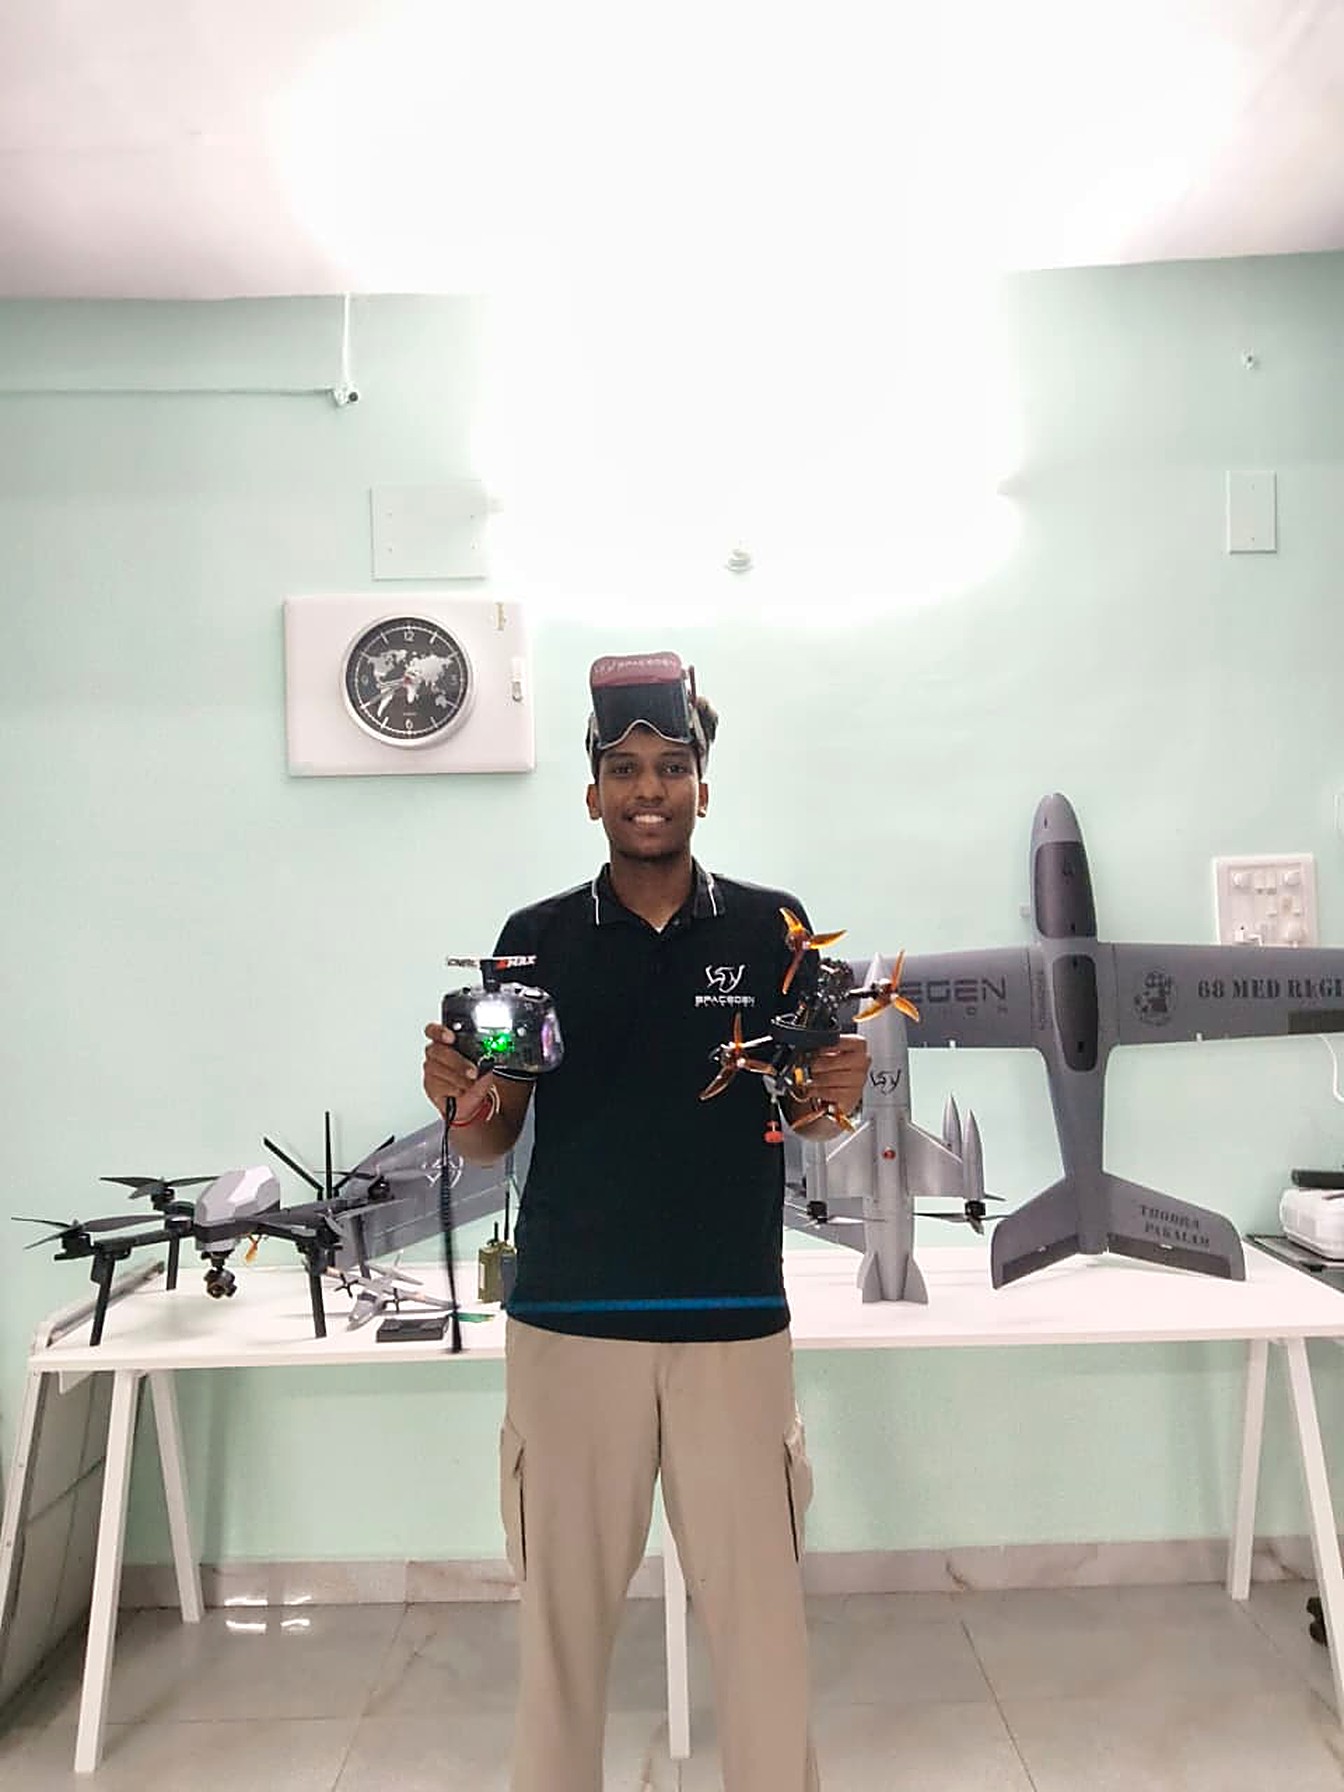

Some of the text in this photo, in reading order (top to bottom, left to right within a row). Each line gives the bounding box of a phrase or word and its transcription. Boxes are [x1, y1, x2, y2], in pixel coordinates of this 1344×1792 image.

[403, 630, 415, 642] 12
[405, 718, 414, 730] 6
[1198, 977, 1343, 998] 68 MED REGI
